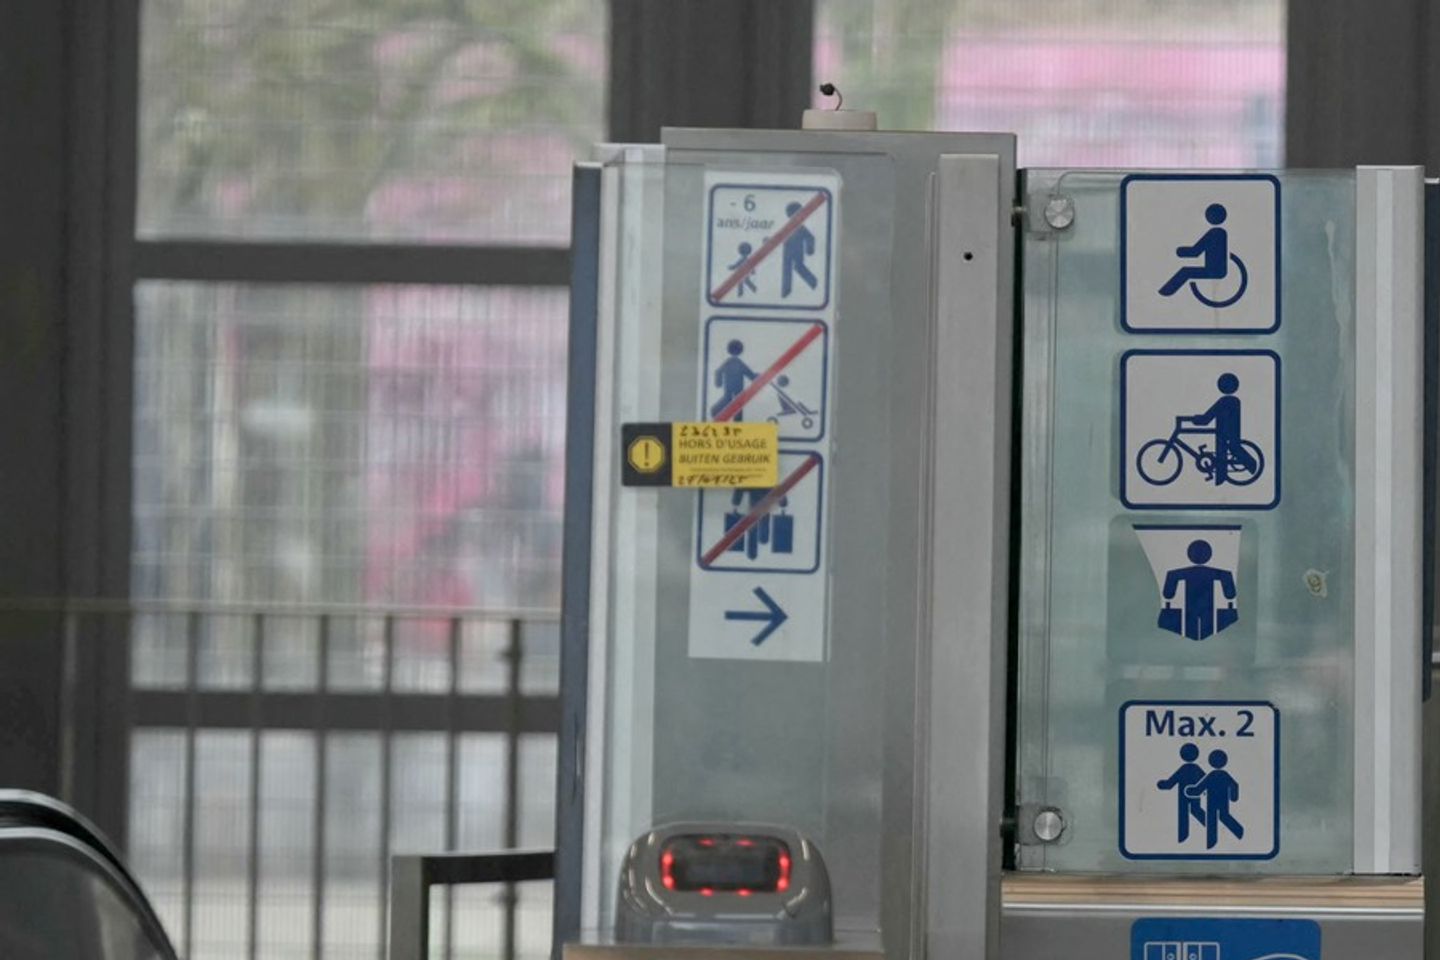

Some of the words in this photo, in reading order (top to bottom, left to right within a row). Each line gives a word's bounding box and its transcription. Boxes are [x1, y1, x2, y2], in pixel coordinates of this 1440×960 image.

[744, 193, 756, 212] 6
[678, 439, 712, 449] HORS
[716, 438, 767, 449] D'USAGE
[678, 453, 720, 464] BUITEN
[723, 453, 770, 464] GEBRUIK
[1145, 710, 1226, 737] Max.
[1236, 710, 1255, 737] 2
